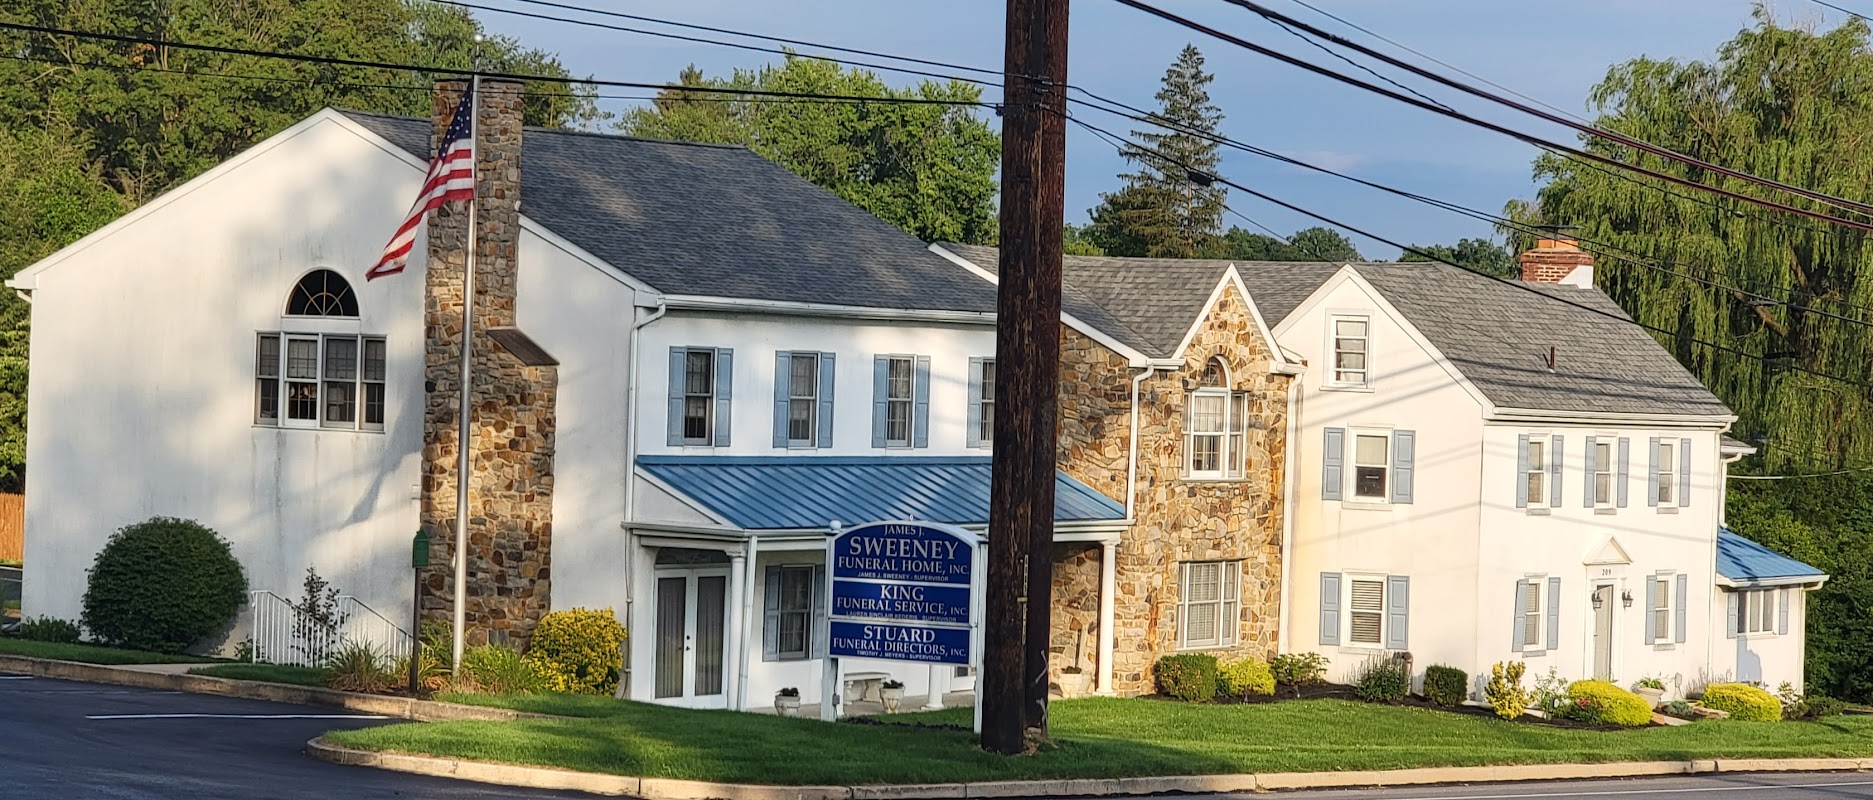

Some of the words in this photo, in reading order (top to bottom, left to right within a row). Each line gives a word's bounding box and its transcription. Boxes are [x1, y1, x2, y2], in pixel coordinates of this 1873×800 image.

[884, 525, 916, 536] JAMES
[918, 526, 925, 537] J.
[849, 536, 959, 560] SWEENEY
[838, 556, 899, 571] FUNERAL
[902, 560, 946, 575] HOME,
[949, 565, 969, 575] INC.
[880, 585, 924, 601] KING
[837, 597, 892, 611] FUNERAL
[894, 601, 948, 615] SERVICE,
[950, 607, 968, 616] INC.
[922, 615, 957, 623] SUPERVISOR
[863, 625, 936, 643] STUARD
[833, 638, 881, 651] FUNERAL
[884, 641, 949, 657] DIRECTORS,
[950, 649, 967, 657] INC.
